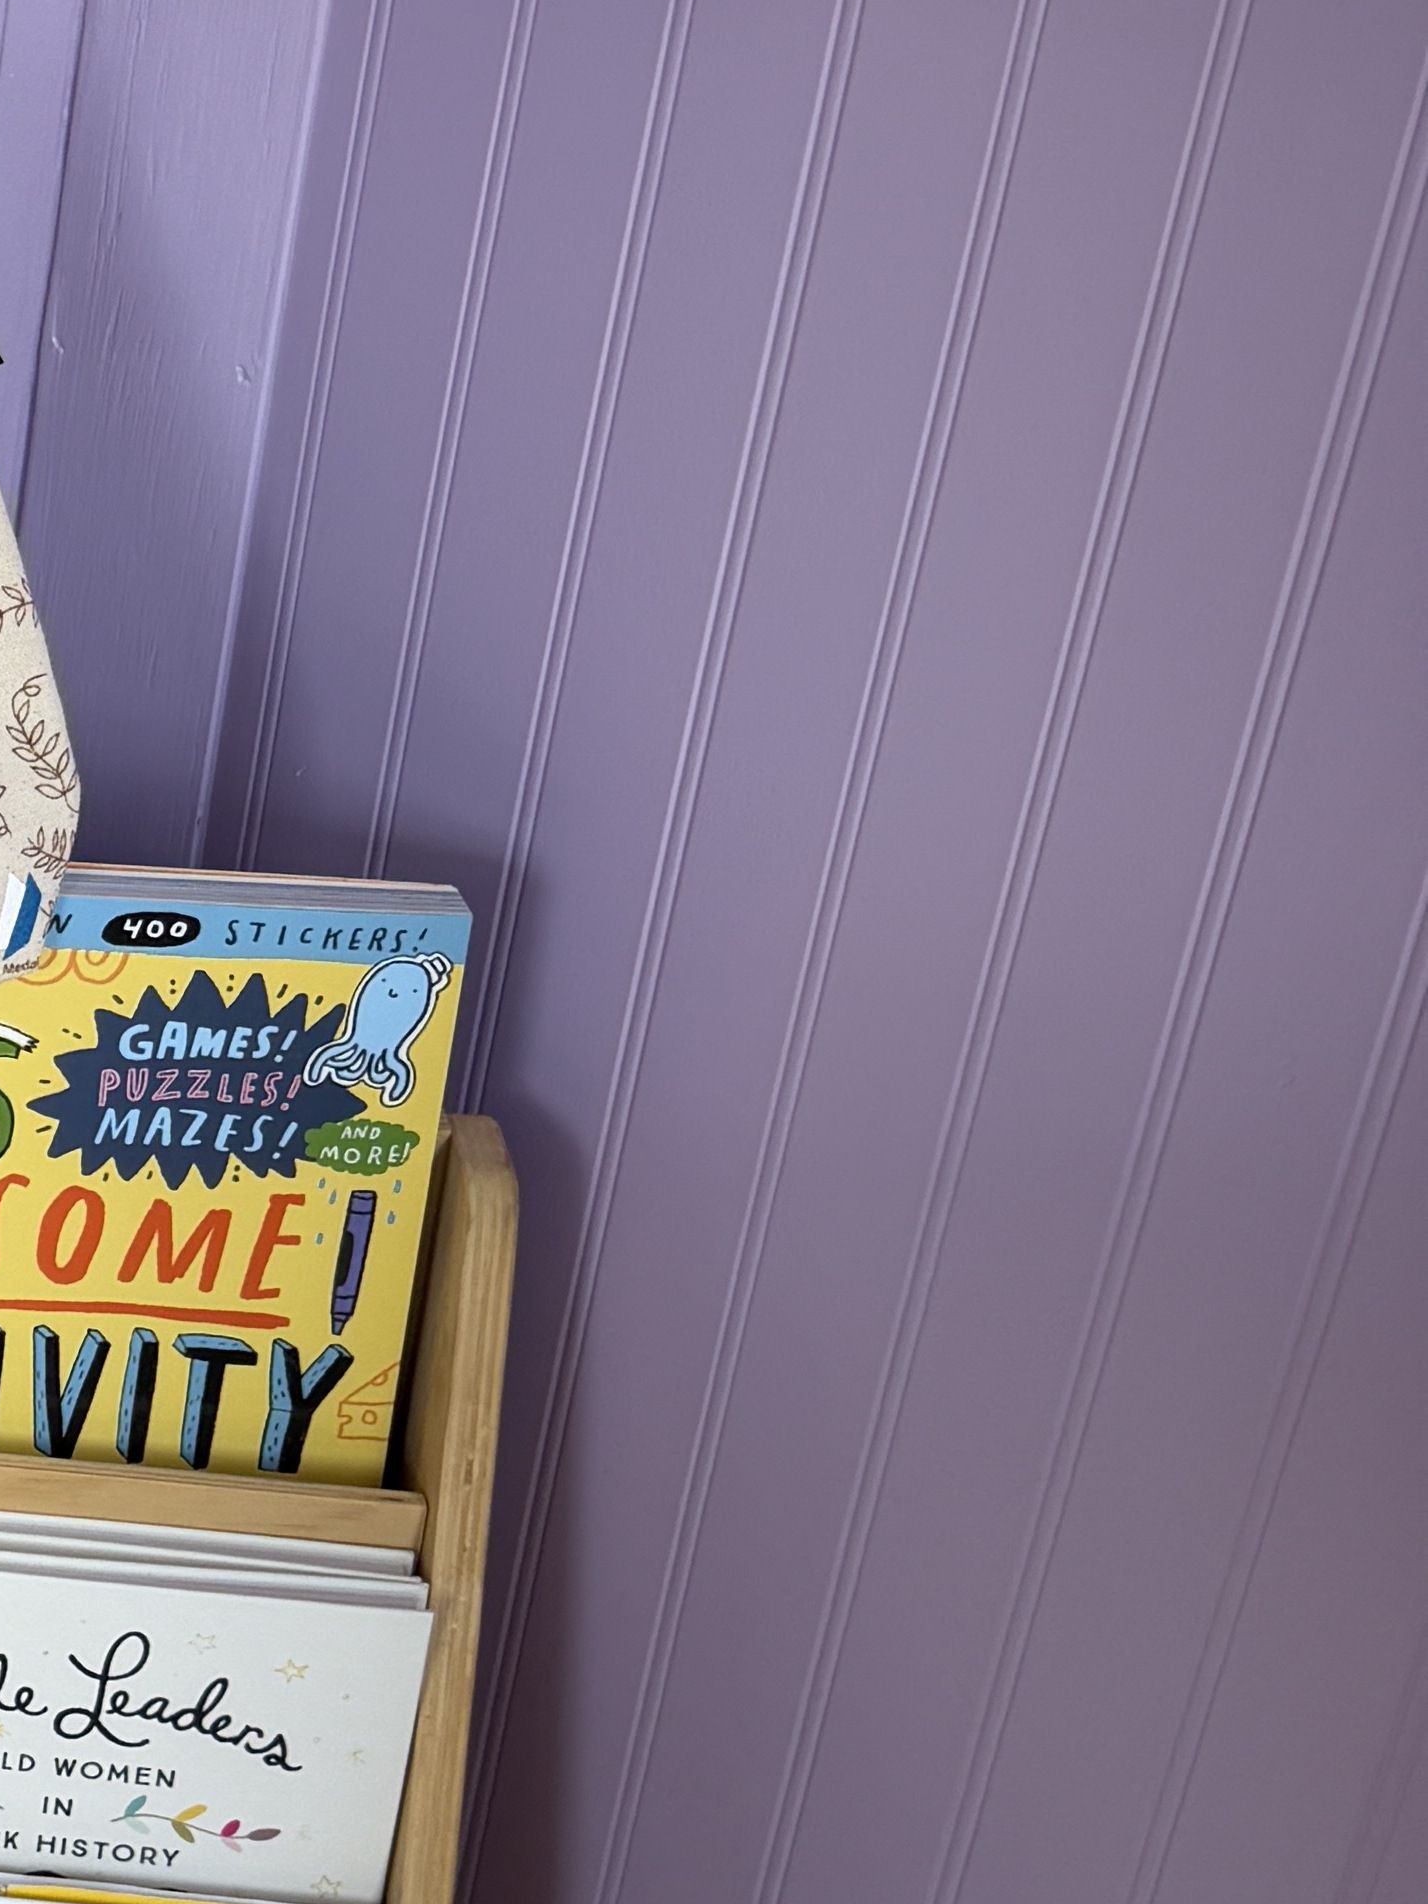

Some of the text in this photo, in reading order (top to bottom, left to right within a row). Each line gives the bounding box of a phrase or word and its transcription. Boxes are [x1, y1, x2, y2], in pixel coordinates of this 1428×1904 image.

[122, 916, 429, 954] 400 STICKERS!
[118, 1019, 298, 1065] GAMES!
[97, 1069, 302, 1109] PUZZLES!
[94, 1107, 299, 1162] MAZES!
[51, 1629, 303, 1773] Leaders
[54, 1757, 177, 1789] WOMEN
[36, 1834, 181, 1868] HISTORY
